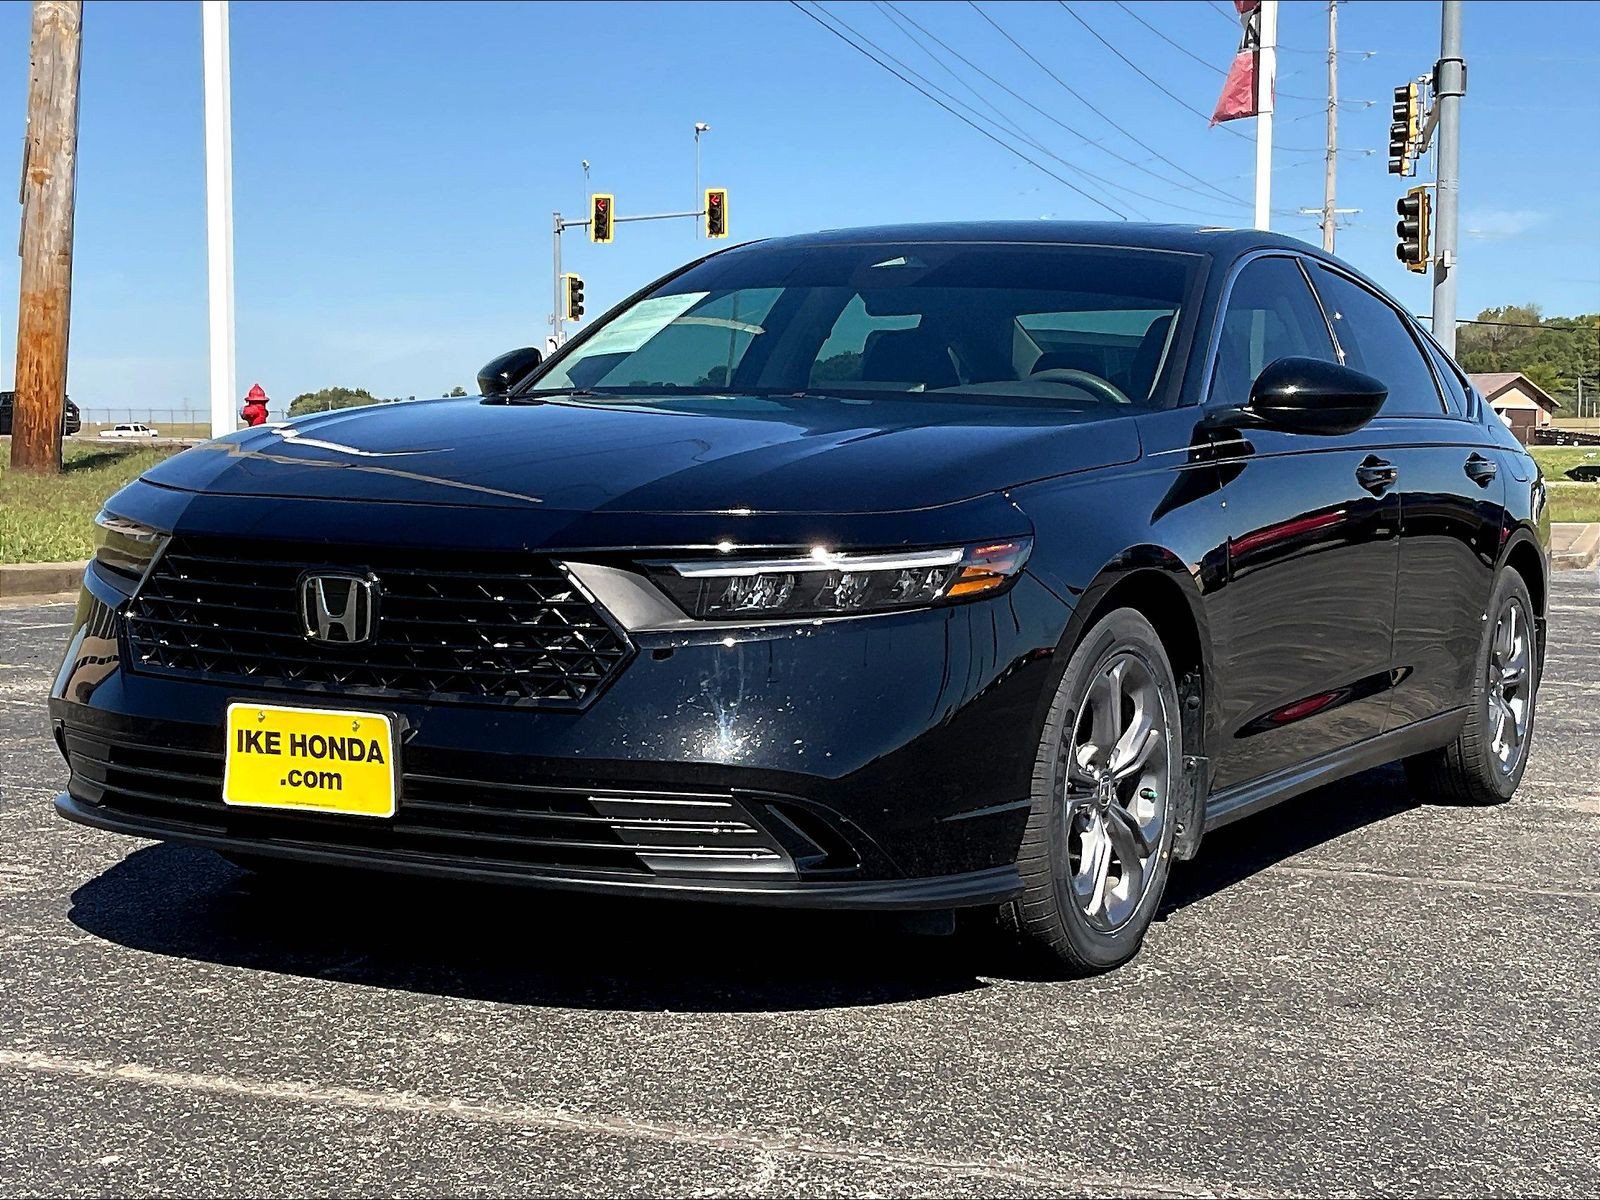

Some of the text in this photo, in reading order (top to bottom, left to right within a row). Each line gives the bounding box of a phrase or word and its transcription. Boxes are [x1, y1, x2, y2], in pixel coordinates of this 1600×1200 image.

[237, 729, 385, 765] IKE HONDA
[280, 769, 343, 790] .com
